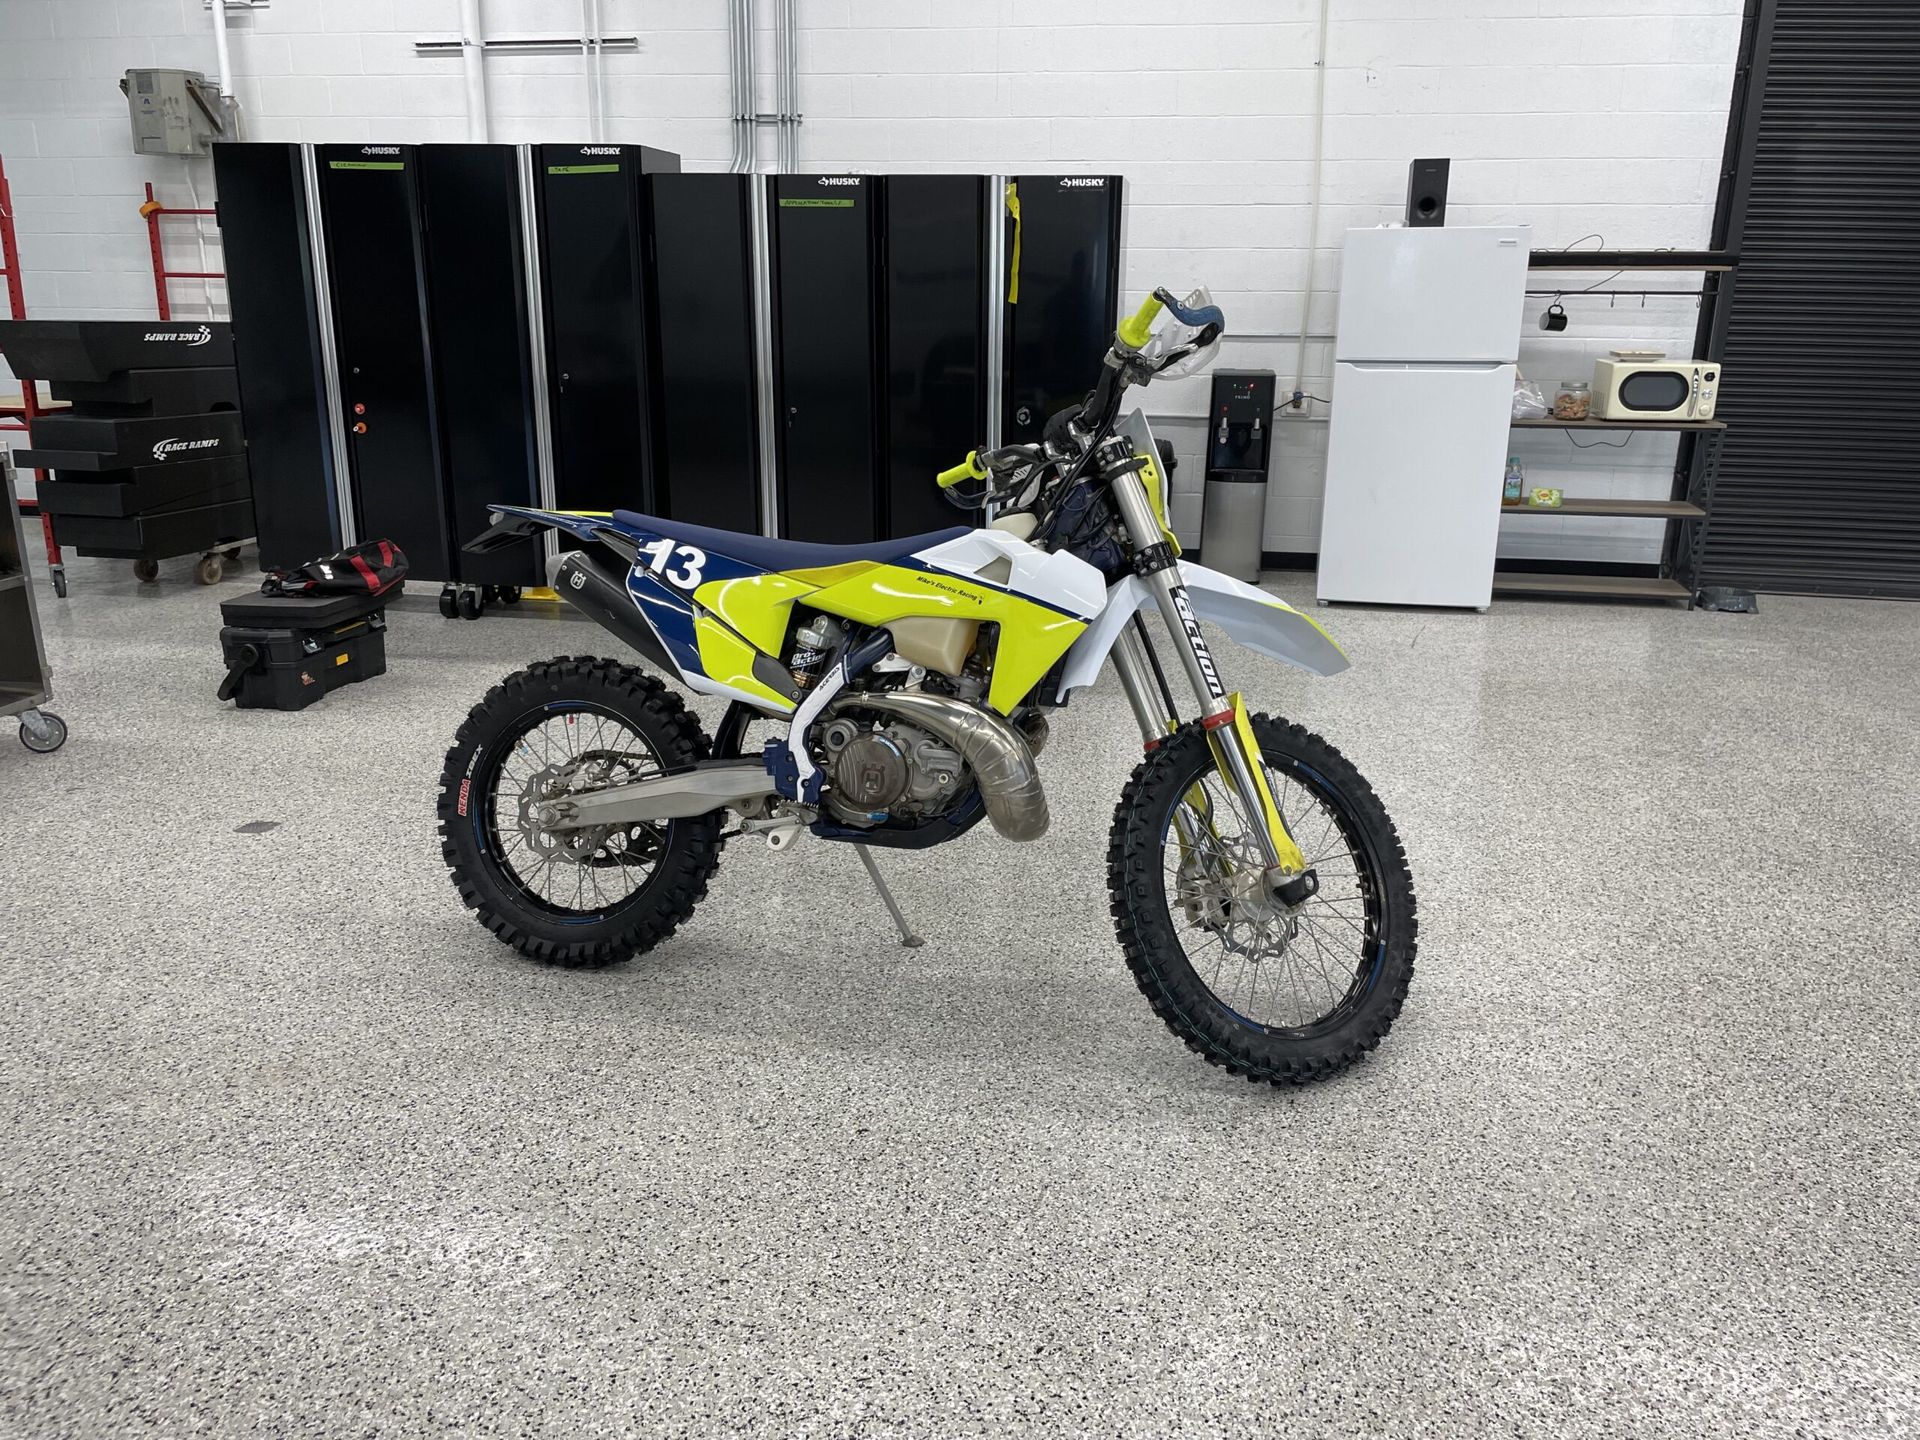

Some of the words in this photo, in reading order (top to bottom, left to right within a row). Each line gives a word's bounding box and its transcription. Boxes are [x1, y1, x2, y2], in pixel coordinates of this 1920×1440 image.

[371, 146, 401, 155] HUSKY
[590, 147, 621, 155] HUSKY
[829, 177, 860, 186] HUSKY
[1071, 178, 1105, 187] HUSKY
[144, 333, 177, 341] RAMPS
[178, 333, 201, 341] RACE
[164, 442, 189, 452] RACE
[188, 438, 220, 450] RAMPS
[638, 538, 706, 590] 13
[916, 575, 935, 586] Mike's
[935, 582, 958, 595] Electric
[957, 589, 978, 602] Racing
[791, 651, 817, 665] pro-
[457, 778, 472, 817] KENDA
